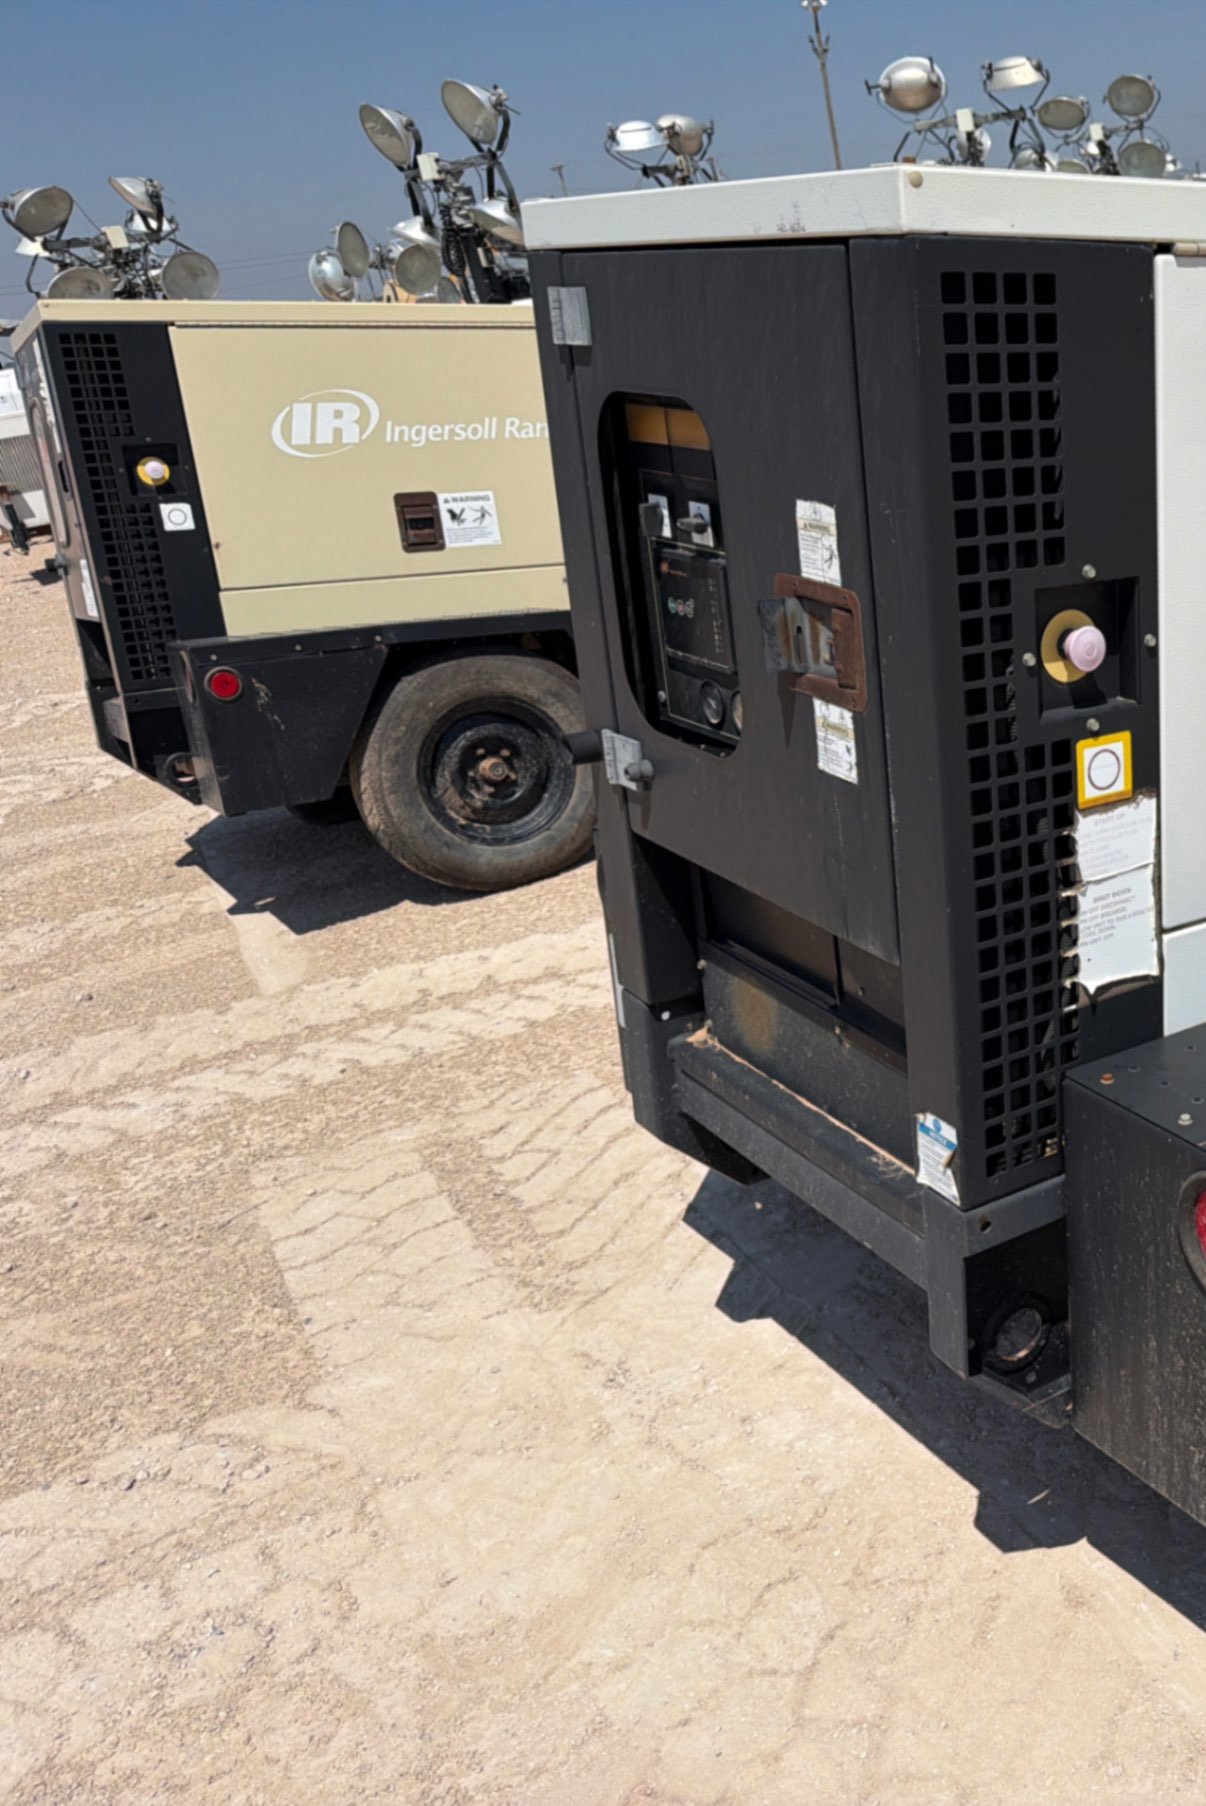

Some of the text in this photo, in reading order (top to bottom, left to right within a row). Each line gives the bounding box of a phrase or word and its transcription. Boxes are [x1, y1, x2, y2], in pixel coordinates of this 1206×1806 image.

[385, 417, 497, 448] Ingersoll
[504, 415, 549, 441] Ran
[451, 494, 491, 503] WARNING
